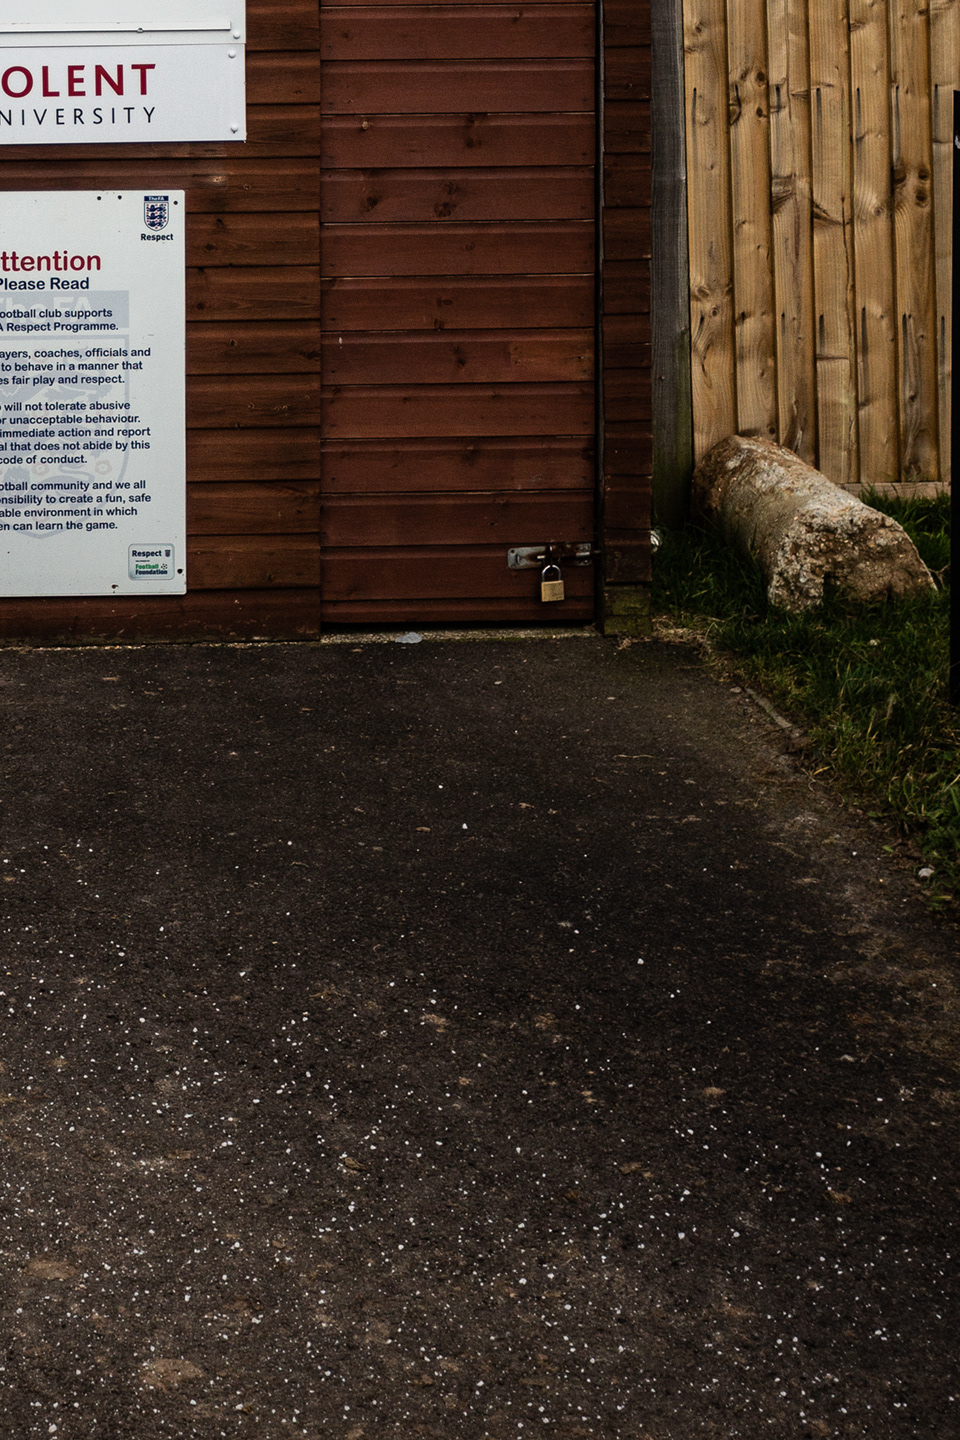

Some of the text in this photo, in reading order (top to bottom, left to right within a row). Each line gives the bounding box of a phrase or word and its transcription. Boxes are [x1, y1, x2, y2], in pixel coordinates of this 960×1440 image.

[140, 233, 174, 242] Respect
[50, 277, 89, 290] Read
[38, 308, 62, 318] club
[64, 308, 113, 319] supports
[6, 322, 51, 333] Respect
[54, 321, 118, 333] Programme.
[34, 348, 82, 359] coaches,
[85, 348, 128, 357] officials
[130, 347, 151, 357] and
[0, 362, 12, 372] to
[14, 362, 54, 372] behave
[56, 362, 66, 371] in
[68, 363, 75, 371] a
[122, 361, 143, 370] that
[11, 375, 30, 385] fair
[32, 375, 56, 387] play
[58, 375, 78, 384] and
[80, 374, 125, 386] respect.
[4, 402, 22, 412] will
[25, 402, 43, 411] not
[44, 401, 87, 411] tolerate
[89, 401, 130, 410] abusive
[9, 415, 83, 426] unacceptable
[85, 414, 140, 423] behaviour.
[0, 428, 56, 438] immediate
[58, 427, 92, 437] action
[94, 427, 114, 437] and
[117, 427, 151, 438] report
[10, 441, 32, 451] that
[33, 441, 60, 451] does
[62, 441, 81, 450] not
[82, 440, 112, 450] abide
[115, 440, 128, 452] by
[130, 440, 150, 449] this
[26, 455, 37, 464] of
[40, 454, 88, 464] conduct.
[30, 481, 90, 493] community
[92, 480, 112, 490] and
[133, 480, 146, 489] all
[45, 494, 57, 504] to
[58, 494, 94, 504] create
[96, 495, 103, 503] a
[105, 493, 126, 504] fun,
[128, 493, 152, 502] safe
[24, 507, 92, 517] environment
[93, 507, 103, 516] in
[106, 506, 138, 516] which
[12, 523, 33, 531] can
[35, 521, 63, 530] learn
[66, 520, 83, 530] the
[85, 522, 118, 532] game.
[132, 550, 162, 558] Respect
